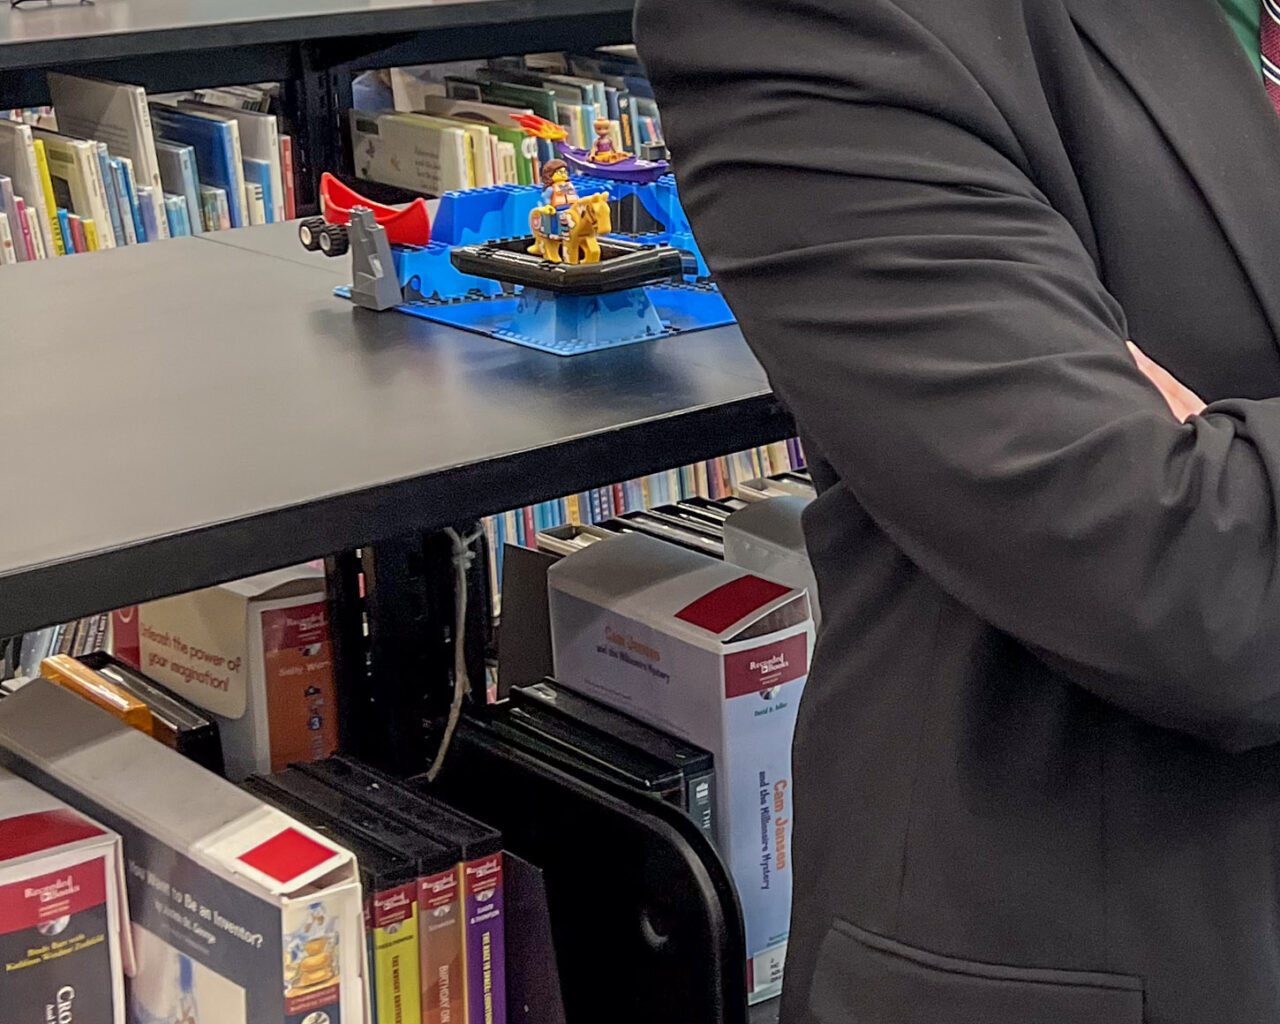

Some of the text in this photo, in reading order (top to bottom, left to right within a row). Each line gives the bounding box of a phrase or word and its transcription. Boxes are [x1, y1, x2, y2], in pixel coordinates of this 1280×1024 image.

[149, 652, 167, 669] your
[172, 636, 188, 655] the
[189, 645, 225, 668] power
[227, 656, 242, 674] of
[750, 653, 785, 671] Recorded
[758, 771, 767, 789] and
[759, 789, 770, 807] the
[773, 779, 789, 872] Cam Jansen
[760, 853, 772, 890] Mystery
[172, 887, 183, 904] to
[184, 893, 197, 912] Be
[199, 905, 212, 921] an
[213, 910, 264, 950] Inventor?
[439, 964, 450, 1008] BIRTHDAY
